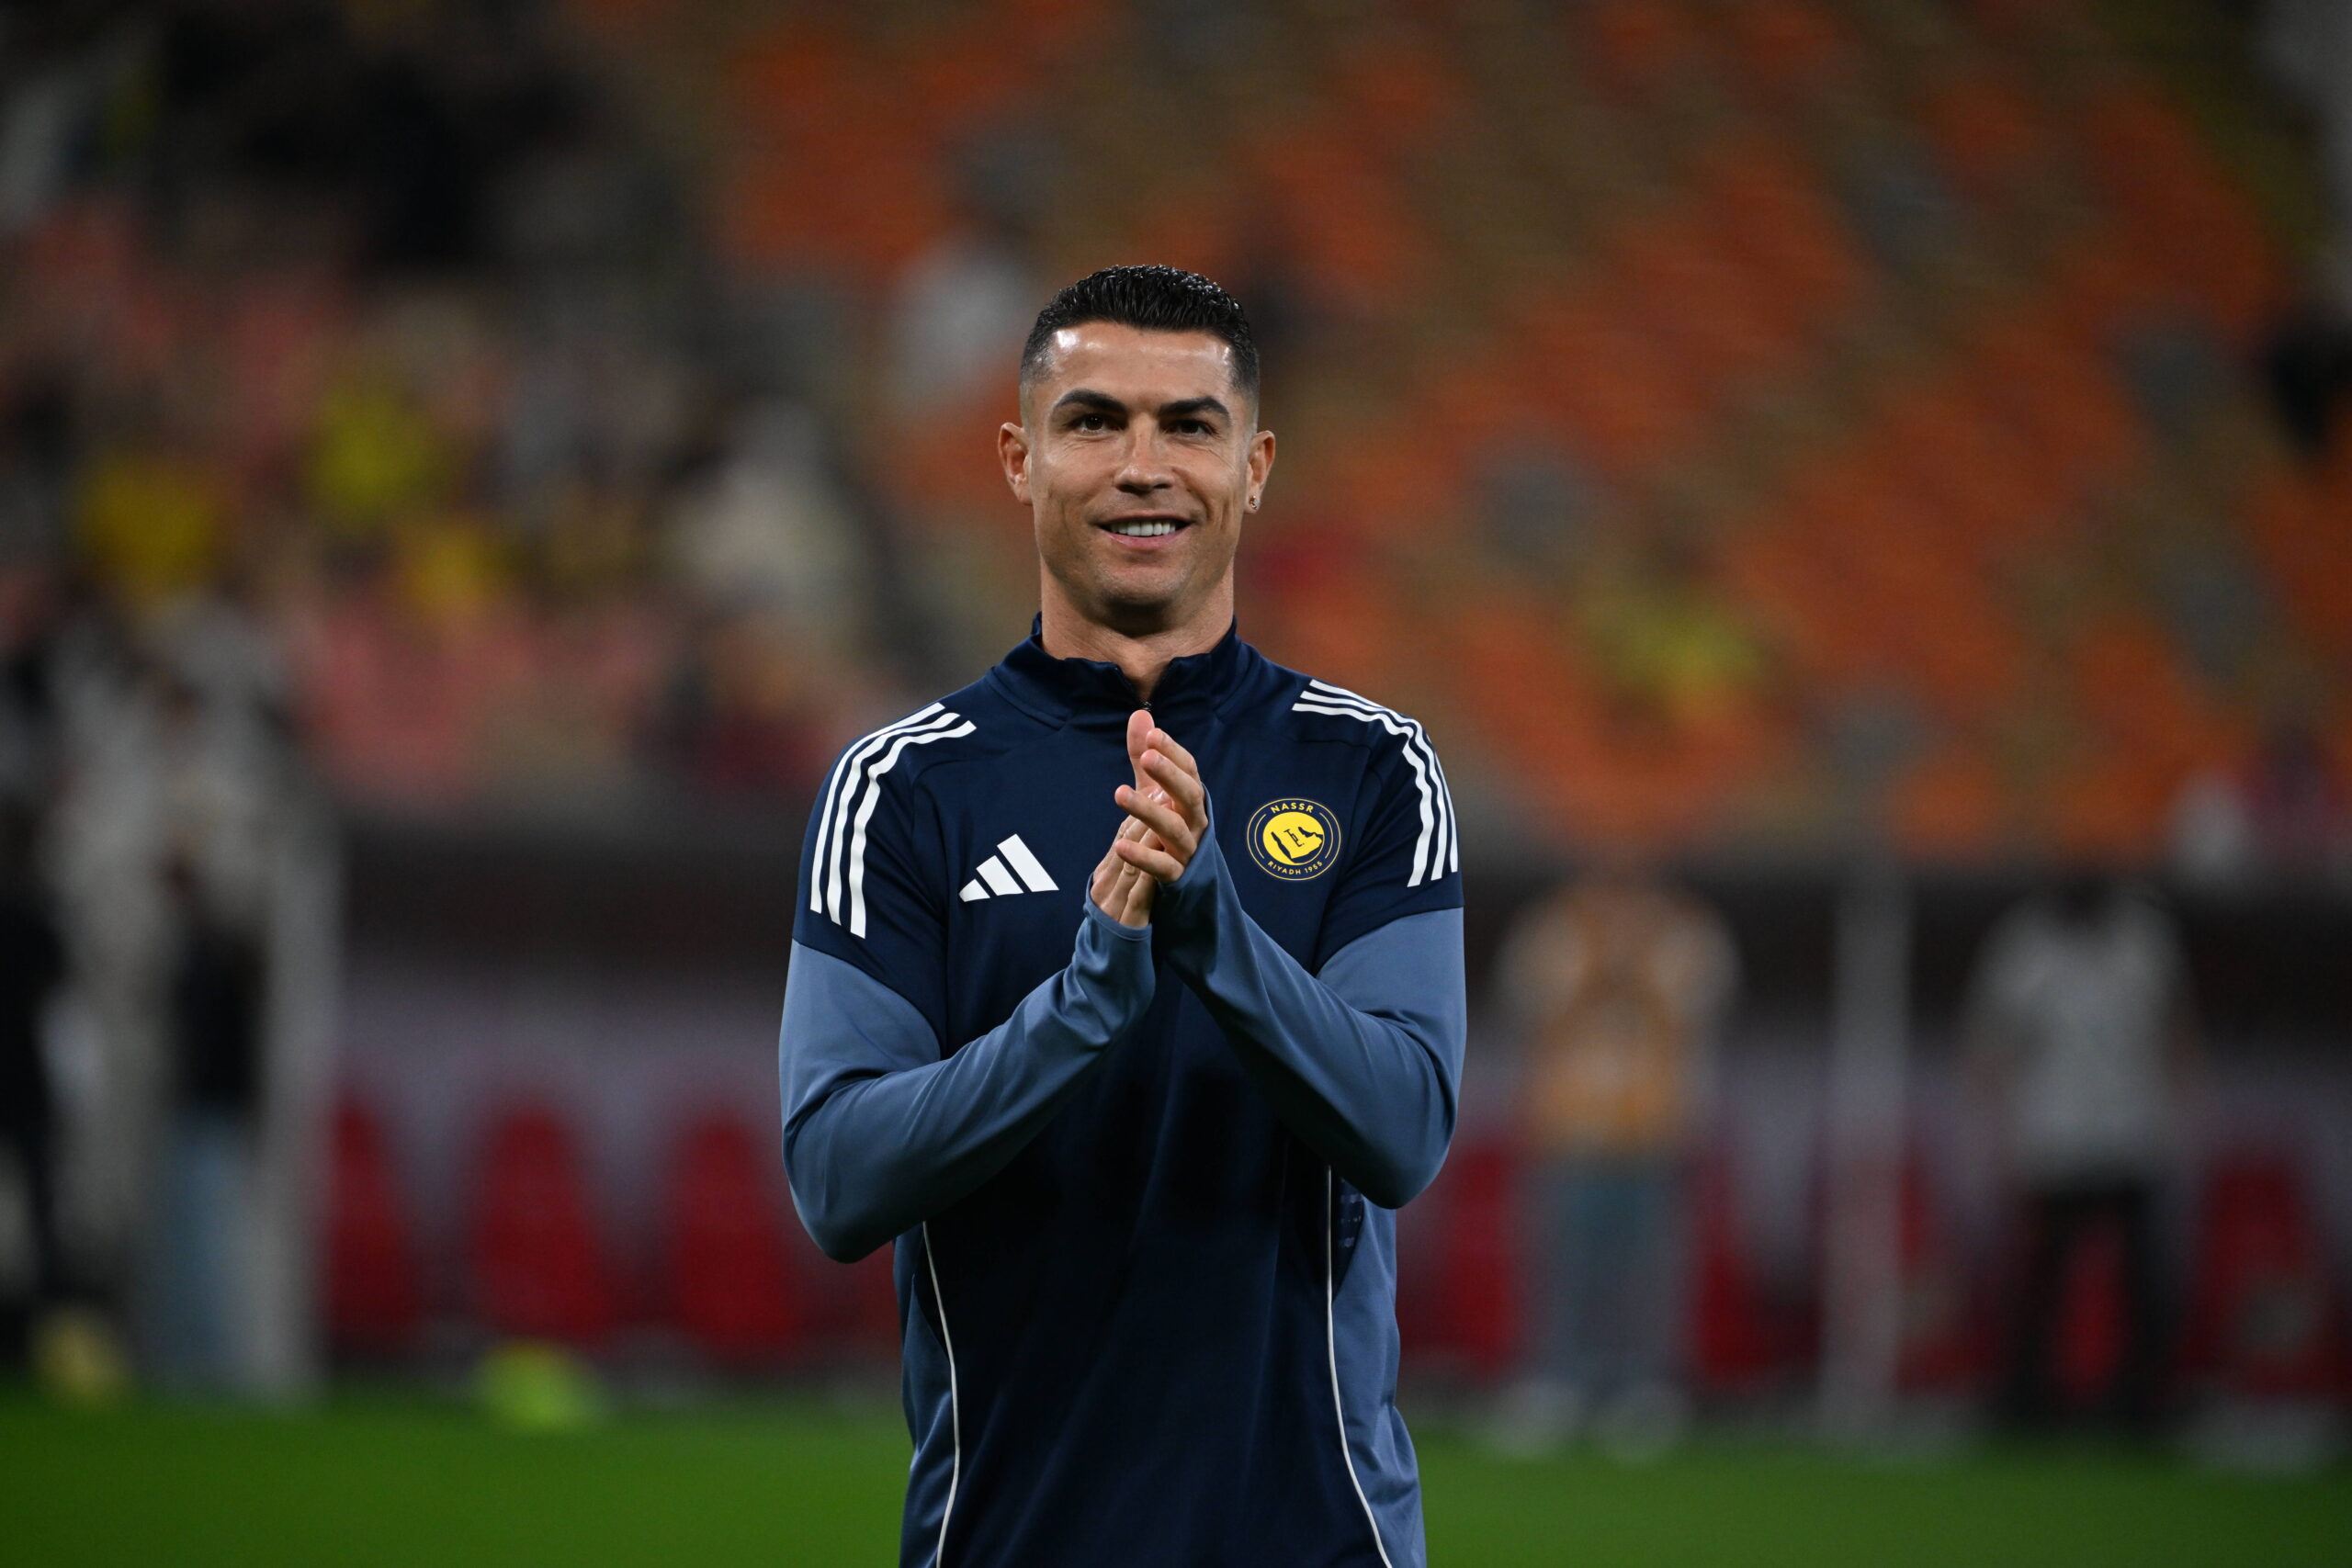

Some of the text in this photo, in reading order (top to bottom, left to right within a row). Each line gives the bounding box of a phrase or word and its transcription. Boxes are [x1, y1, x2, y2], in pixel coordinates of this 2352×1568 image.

[1270, 802, 1314, 814] NASSR
[1268, 861, 1323, 874] RIYADH 1955
